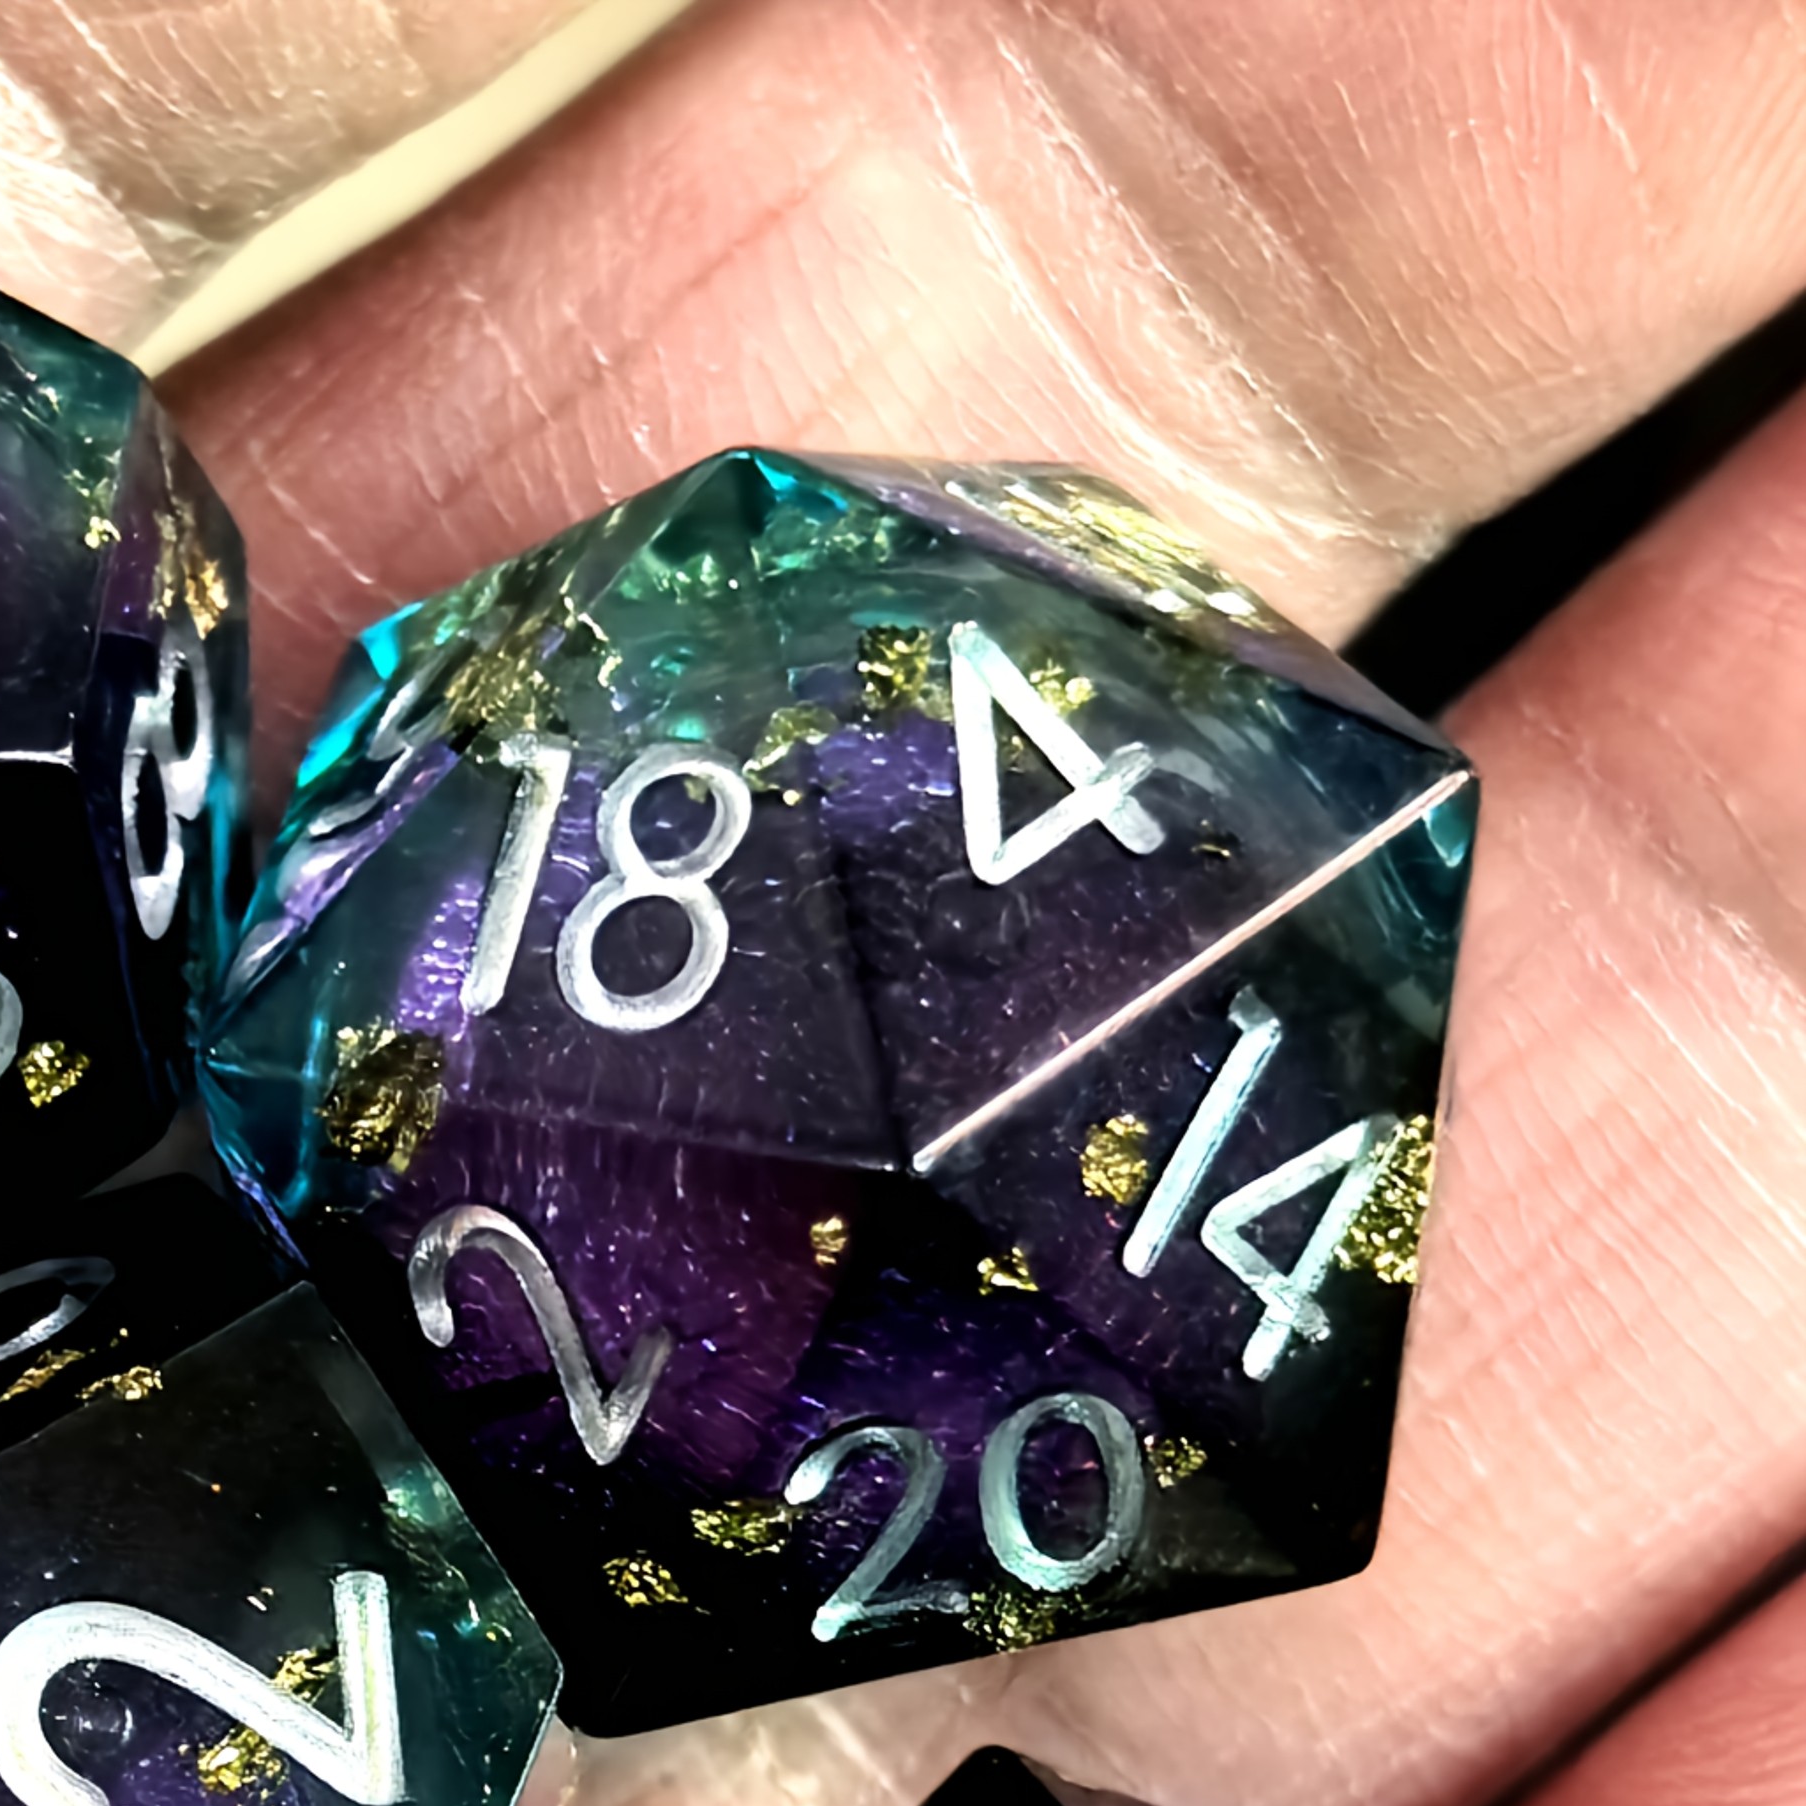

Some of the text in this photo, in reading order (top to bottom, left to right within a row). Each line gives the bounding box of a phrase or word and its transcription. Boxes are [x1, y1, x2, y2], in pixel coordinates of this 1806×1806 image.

[460, 734, 752, 1032] 18
[947, 620, 1166, 884] 4
[1123, 986, 1394, 1379] 14
[407, 1205, 674, 1465] 2
[785, 1391, 1152, 1642] 20
